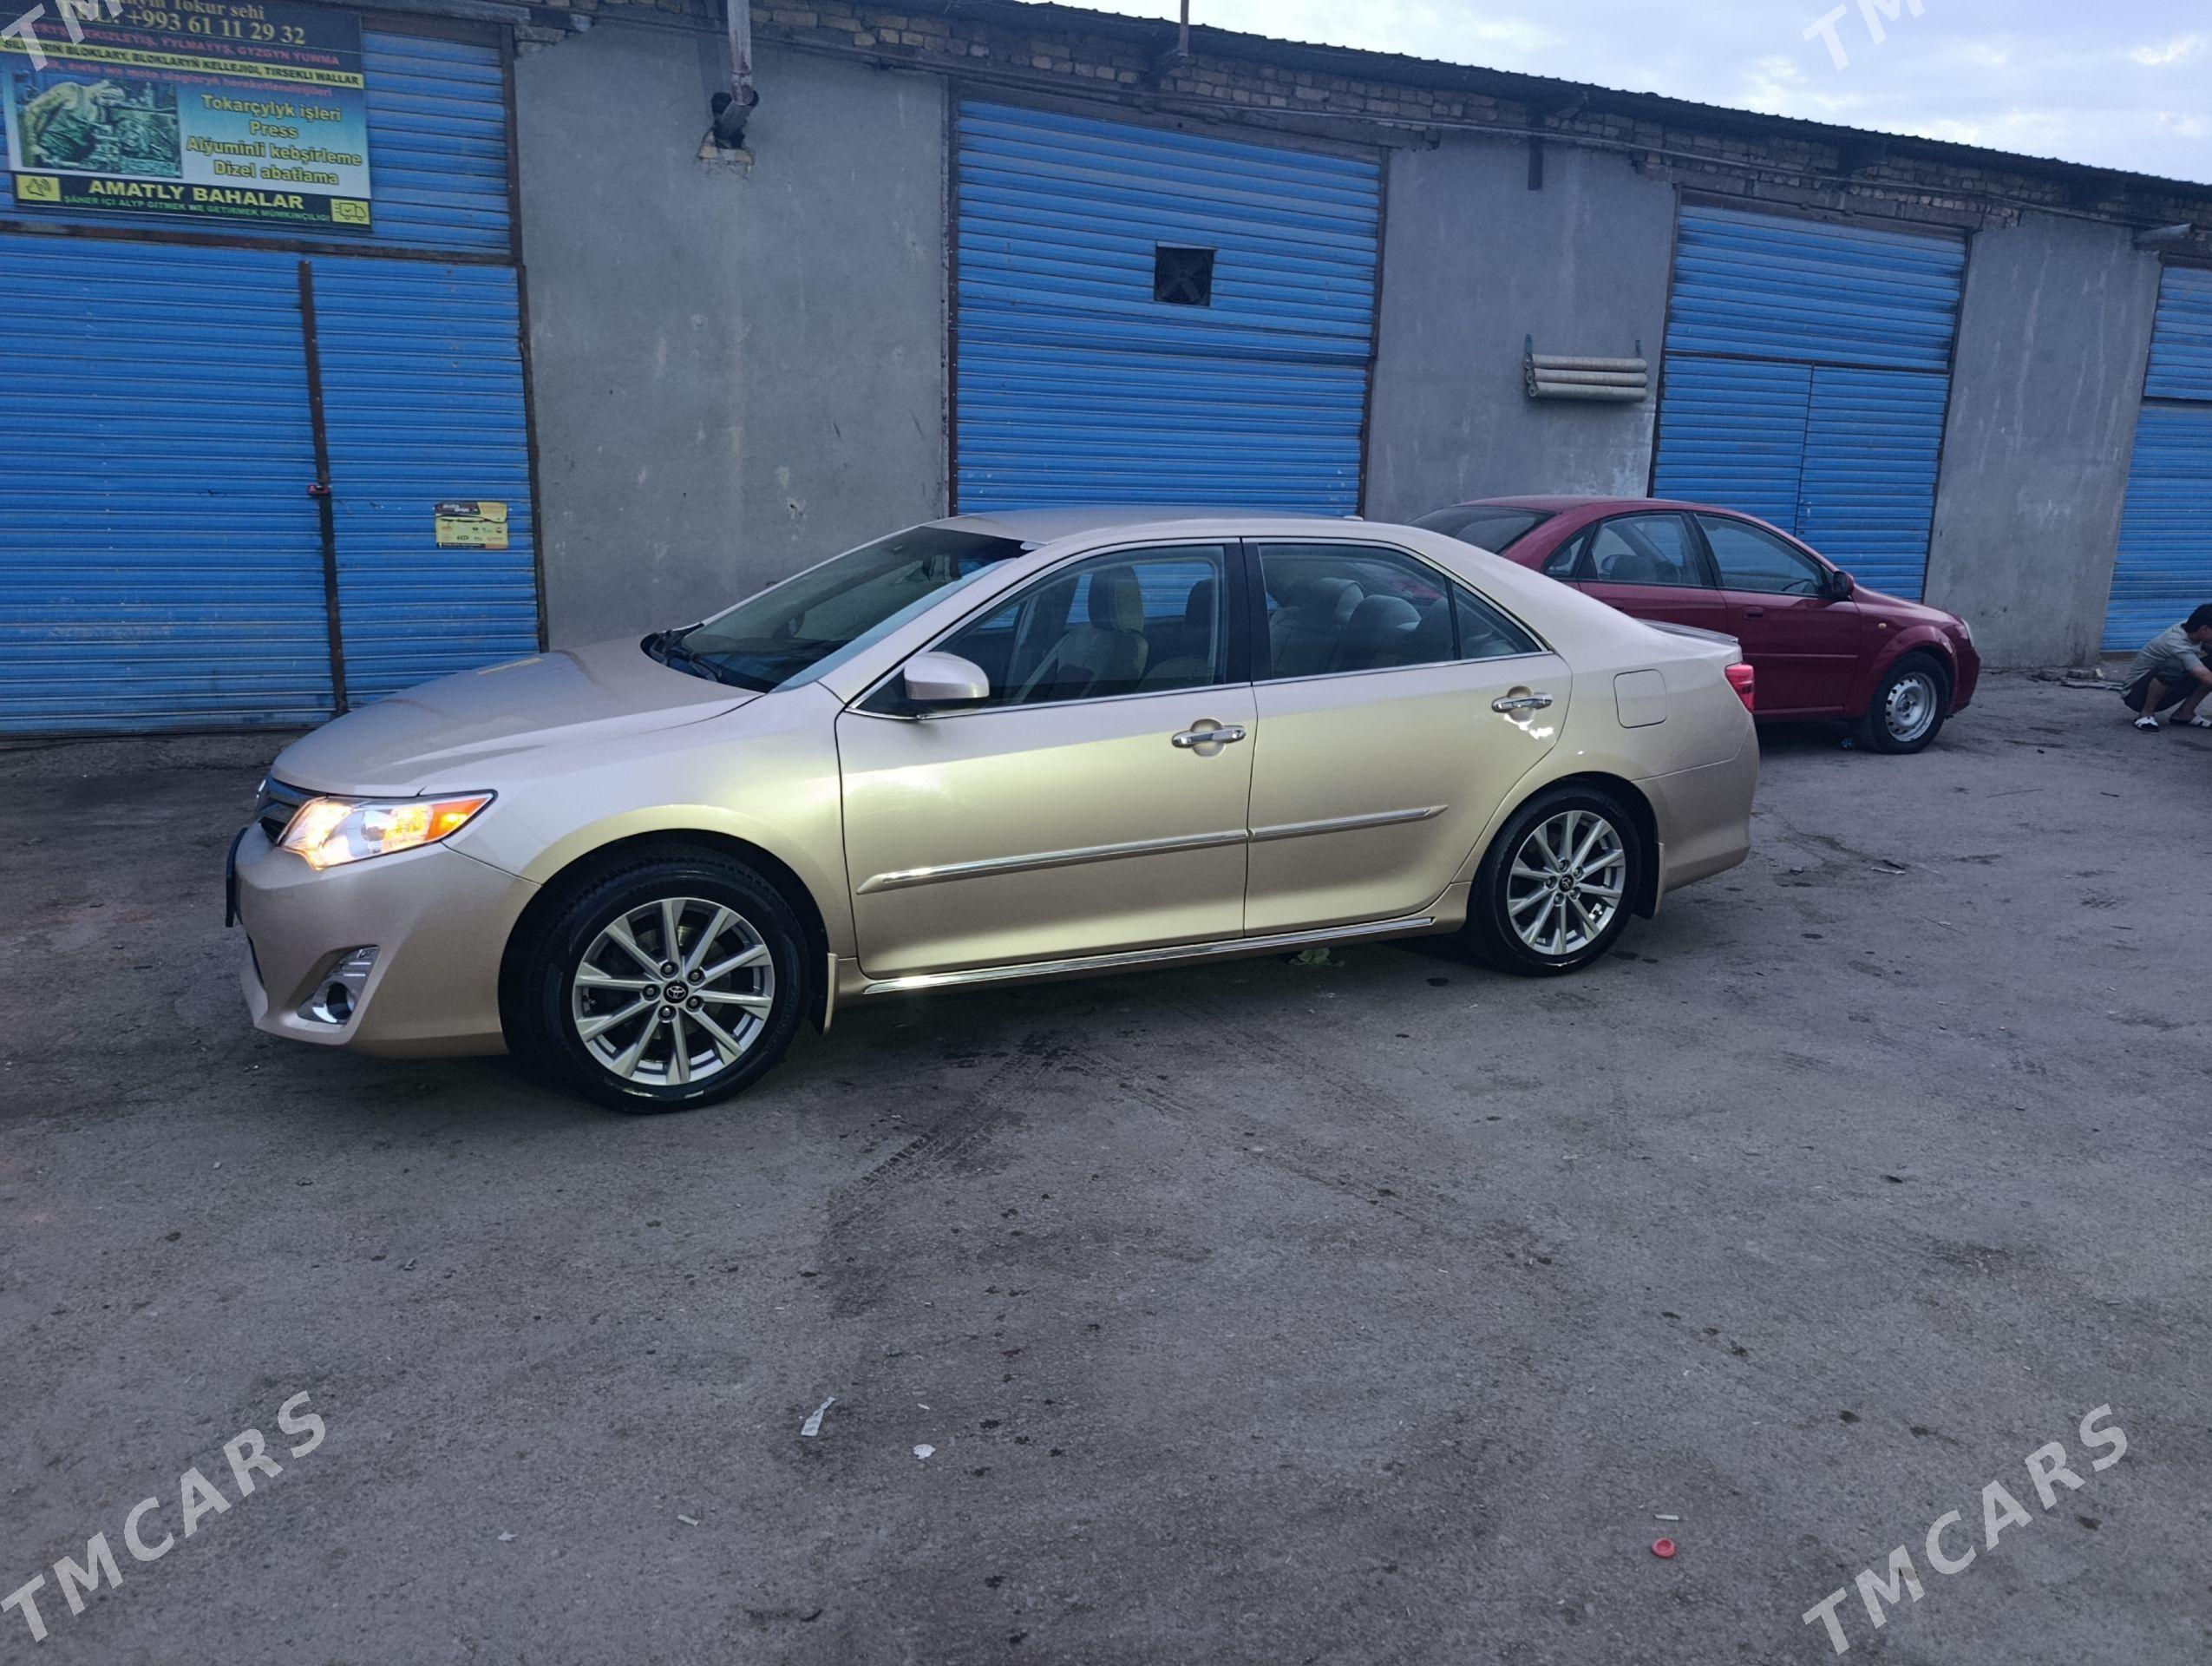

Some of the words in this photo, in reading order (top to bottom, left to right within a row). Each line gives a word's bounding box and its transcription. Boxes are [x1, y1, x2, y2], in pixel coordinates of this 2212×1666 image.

[125, 10, 182, 31] +993
[187, 16, 213, 35] 61
[220, 19, 243, 38] 11
[249, 23, 275, 41] 29
[280, 26, 305, 44] 32
[314, 71, 359, 86] WALLAR
[201, 94, 296, 119] Tokarçylyk
[299, 105, 342, 123] işleri
[249, 120, 299, 140] Press
[270, 141, 363, 166] kebşirleme
[213, 160, 257, 179] Dizel
[260, 165, 340, 186] abatlama
[88, 180, 186, 200] AMATLY
[193, 187, 304, 210] BAHALAR
